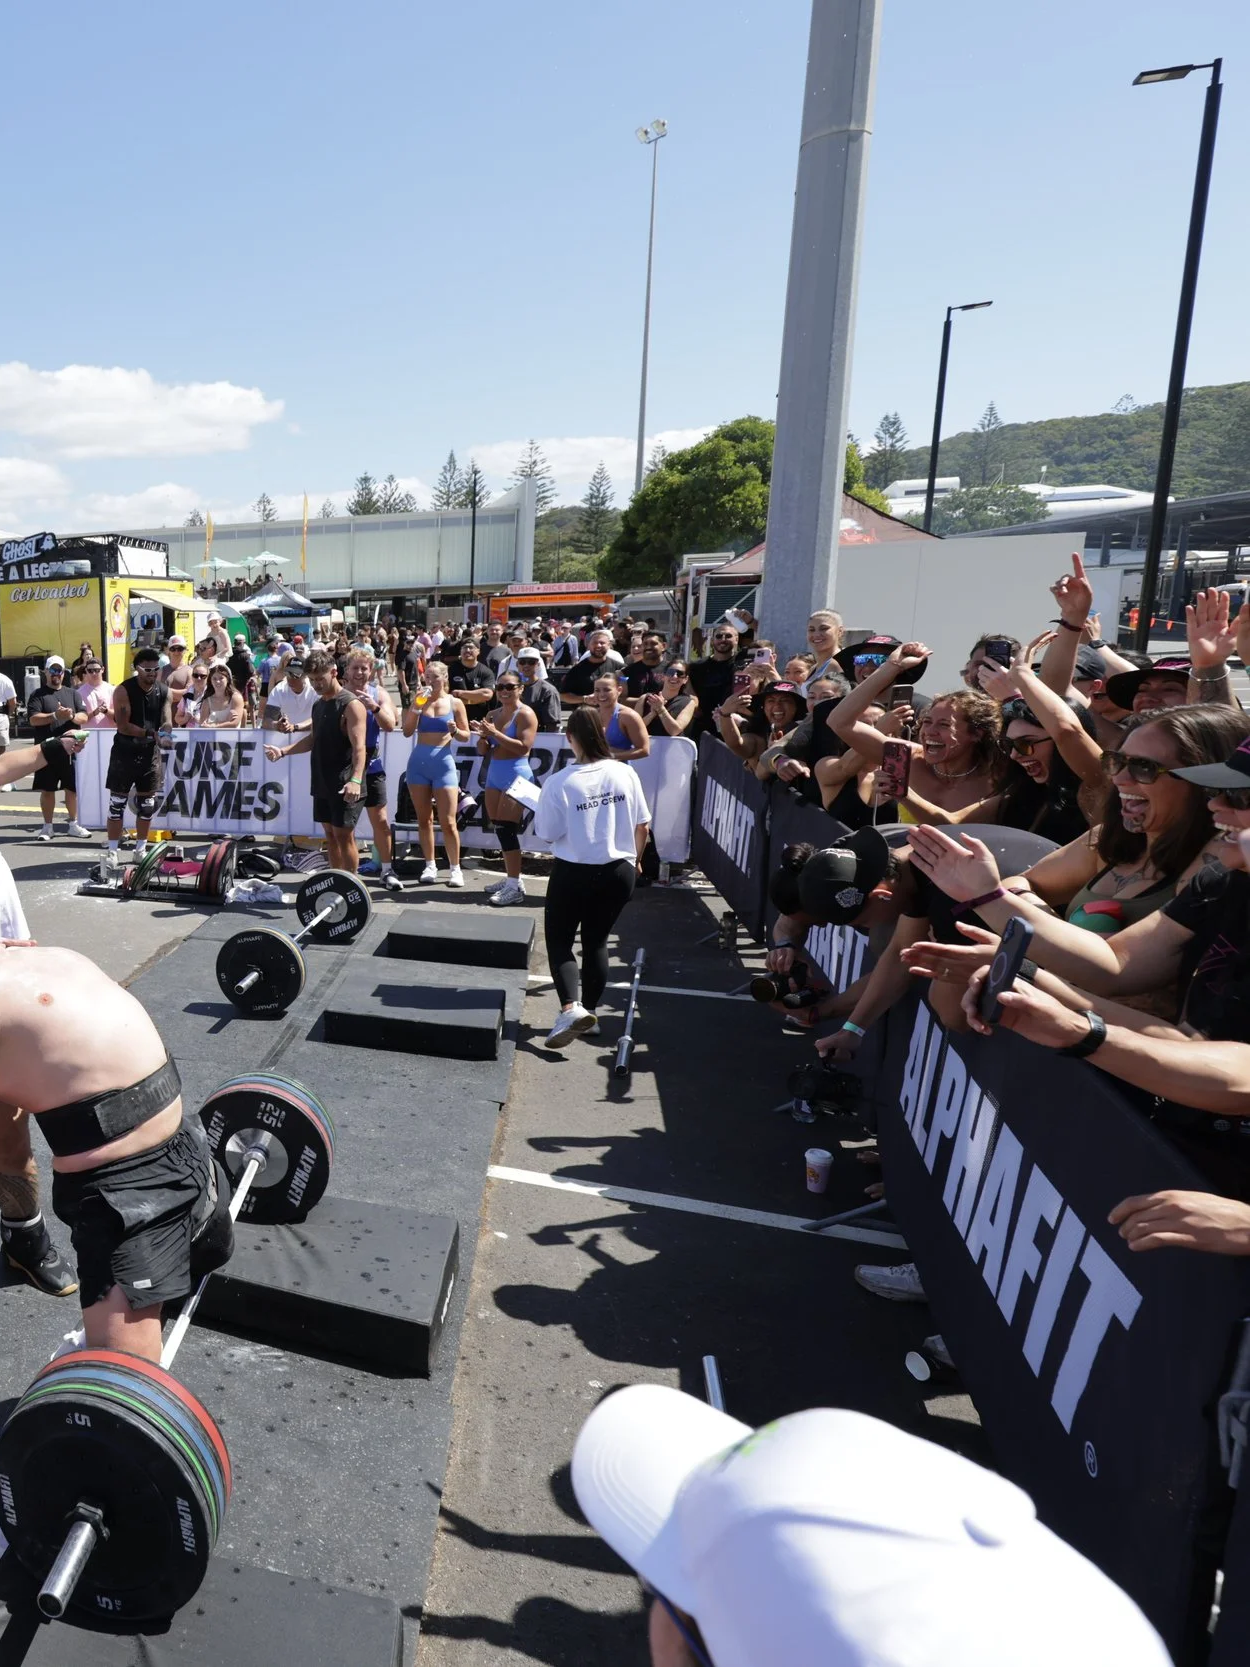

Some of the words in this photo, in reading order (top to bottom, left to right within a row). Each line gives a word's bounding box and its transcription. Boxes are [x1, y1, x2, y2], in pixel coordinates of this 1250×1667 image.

[2, 537, 42, 562] GHOST
[9, 565, 19, 580] A
[509, 585, 535, 593] SUSHI
[543, 584, 562, 592] RICE
[566, 582, 596, 591] BOWLS
[576, 800, 599, 811] HEAD
[601, 794, 626, 806] CREW
[701, 775, 755, 875] ALPHAFIT
[305, 877, 335, 897] ALPHAFIT
[328, 918, 359, 938] ALPHAFIT
[286, 1145, 318, 1208] ALPHAFIT
[899, 999, 1143, 1435] ALPHAFIT
[74, 1411, 92, 1428] 5
[176, 1496, 197, 1556] ALPHAFIT
[96, 1594, 114, 1611] 5
